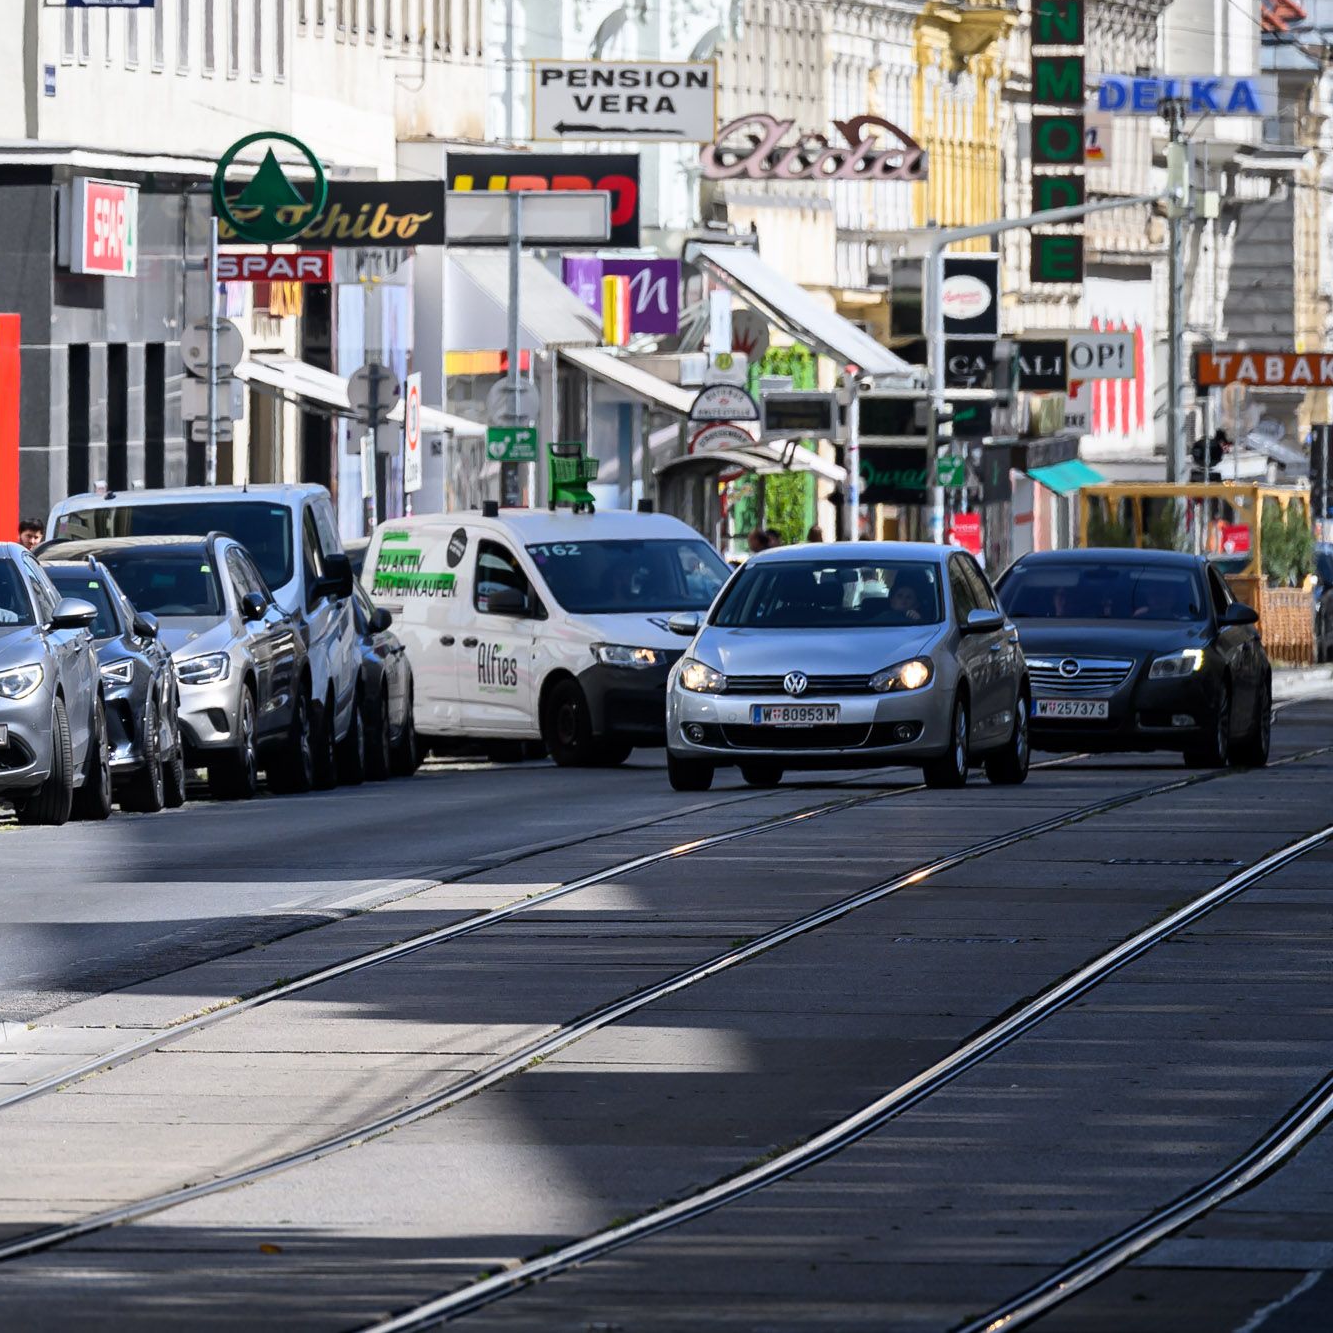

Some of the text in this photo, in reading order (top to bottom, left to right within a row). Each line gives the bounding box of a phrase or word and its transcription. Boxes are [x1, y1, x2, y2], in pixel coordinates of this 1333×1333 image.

[540, 69, 708, 88] PENSION
[573, 94, 676, 114] VERA
[217, 256, 322, 279] SPAR
[394, 555, 425, 572] AKTIV
[397, 580, 457, 597] EINKAUFEN
[478, 643, 517, 687] Alfies
[782, 708, 824, 721] 80953
